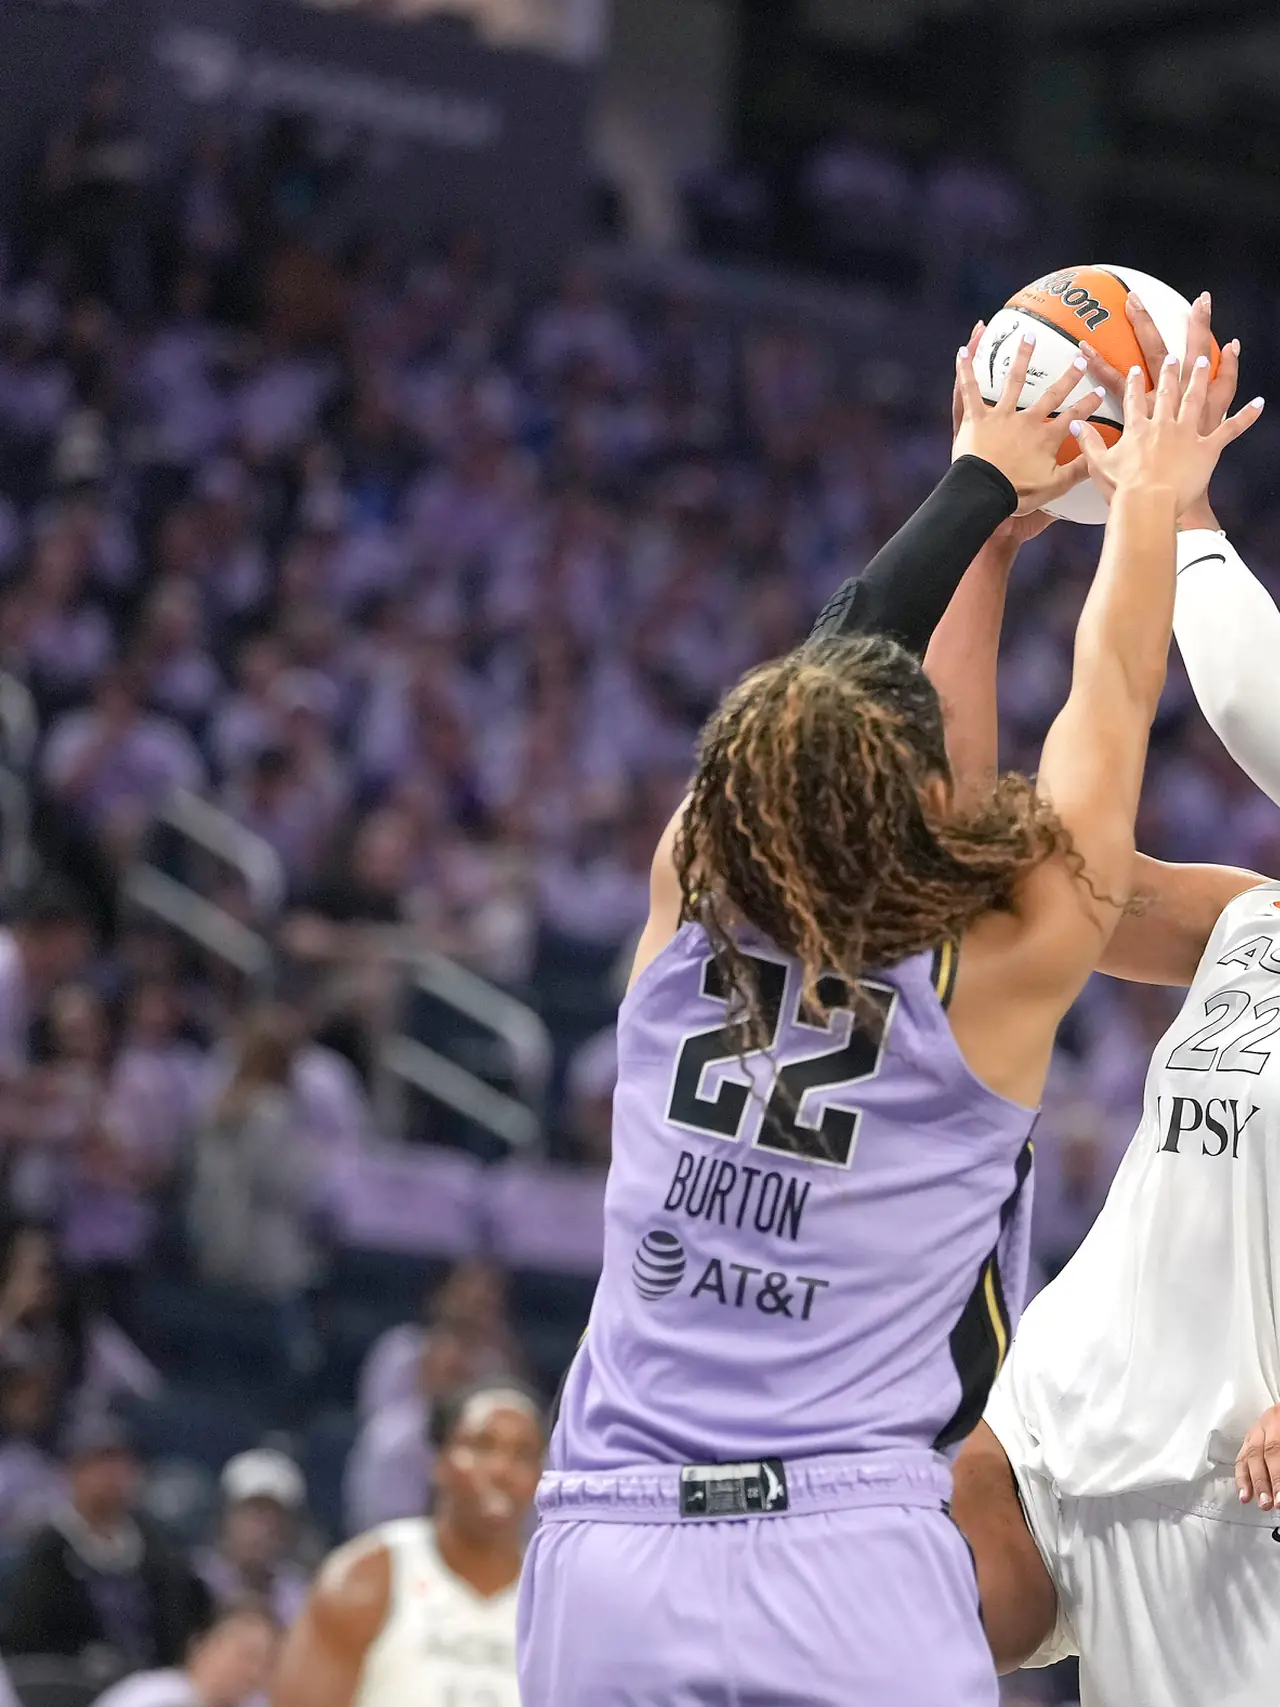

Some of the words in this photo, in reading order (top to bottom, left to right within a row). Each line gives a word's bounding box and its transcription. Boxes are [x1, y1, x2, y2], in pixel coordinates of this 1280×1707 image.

[664, 949, 899, 1170] 22
[663, 1151, 810, 1241] BURTON
[691, 1258, 830, 1321] AT&T
